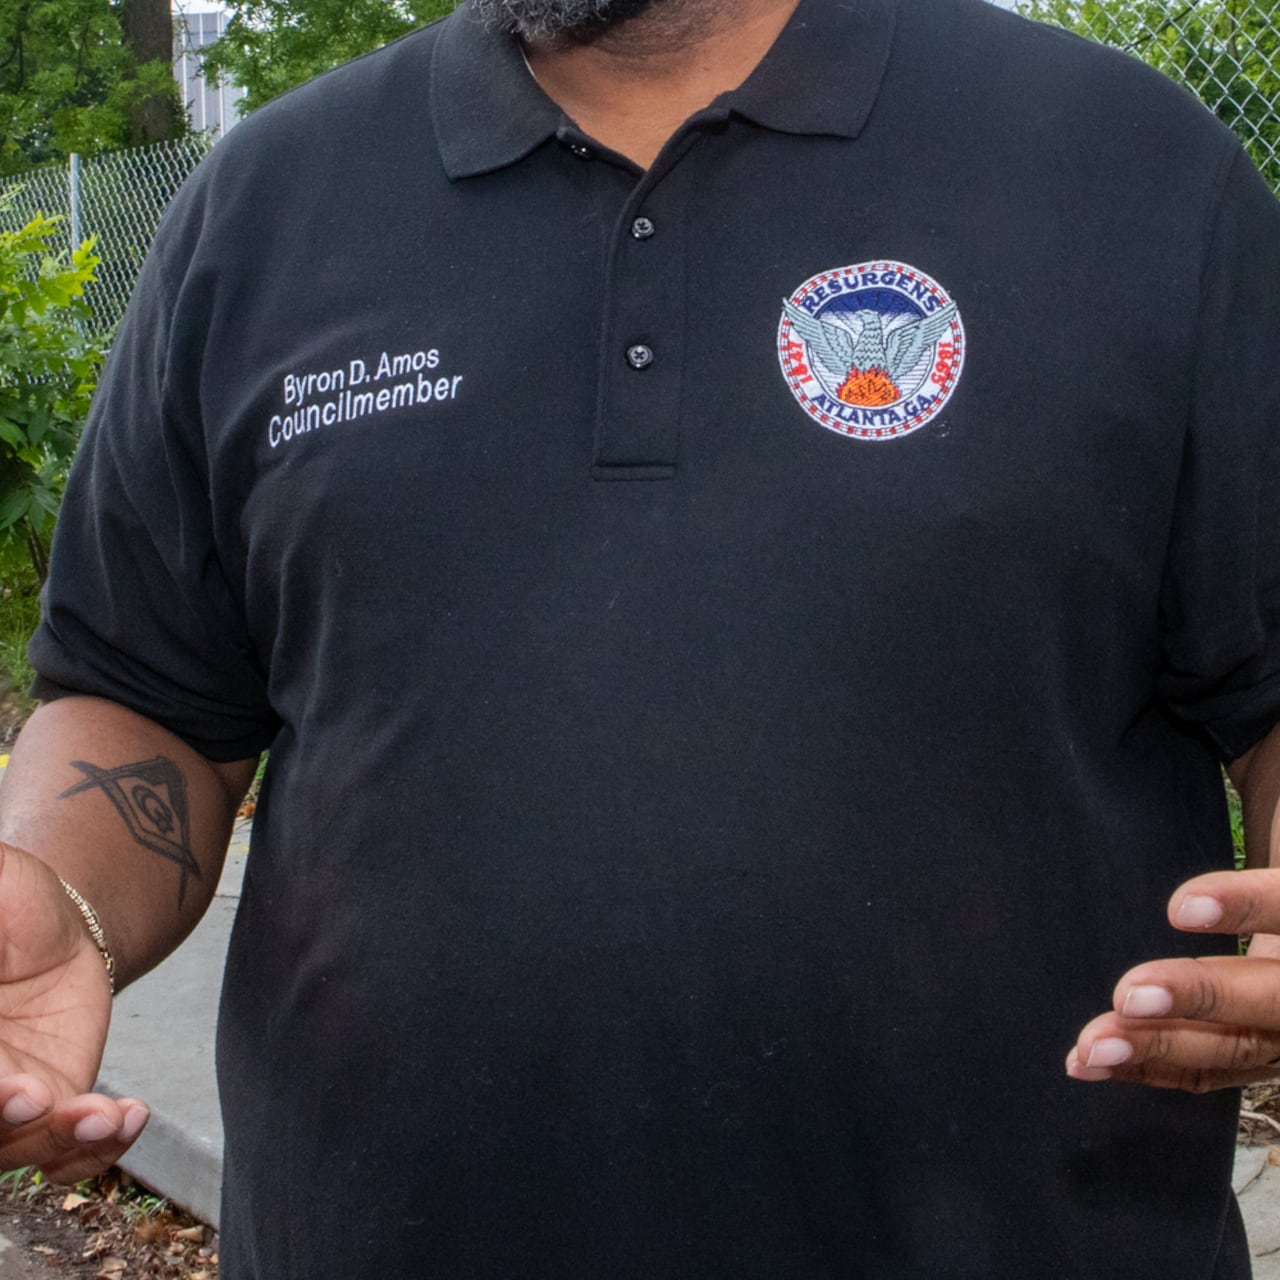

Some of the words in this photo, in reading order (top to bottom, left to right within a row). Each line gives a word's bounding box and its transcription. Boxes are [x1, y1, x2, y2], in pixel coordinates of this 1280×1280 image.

[800, 271, 943, 315] RESURGENS
[283, 368, 344, 407] Byron
[348, 359, 370, 386] D.
[373, 347, 440, 381] Amos
[788, 340, 814, 384] 1847
[930, 341, 954, 385] 1865
[268, 372, 464, 448] Councilmember
